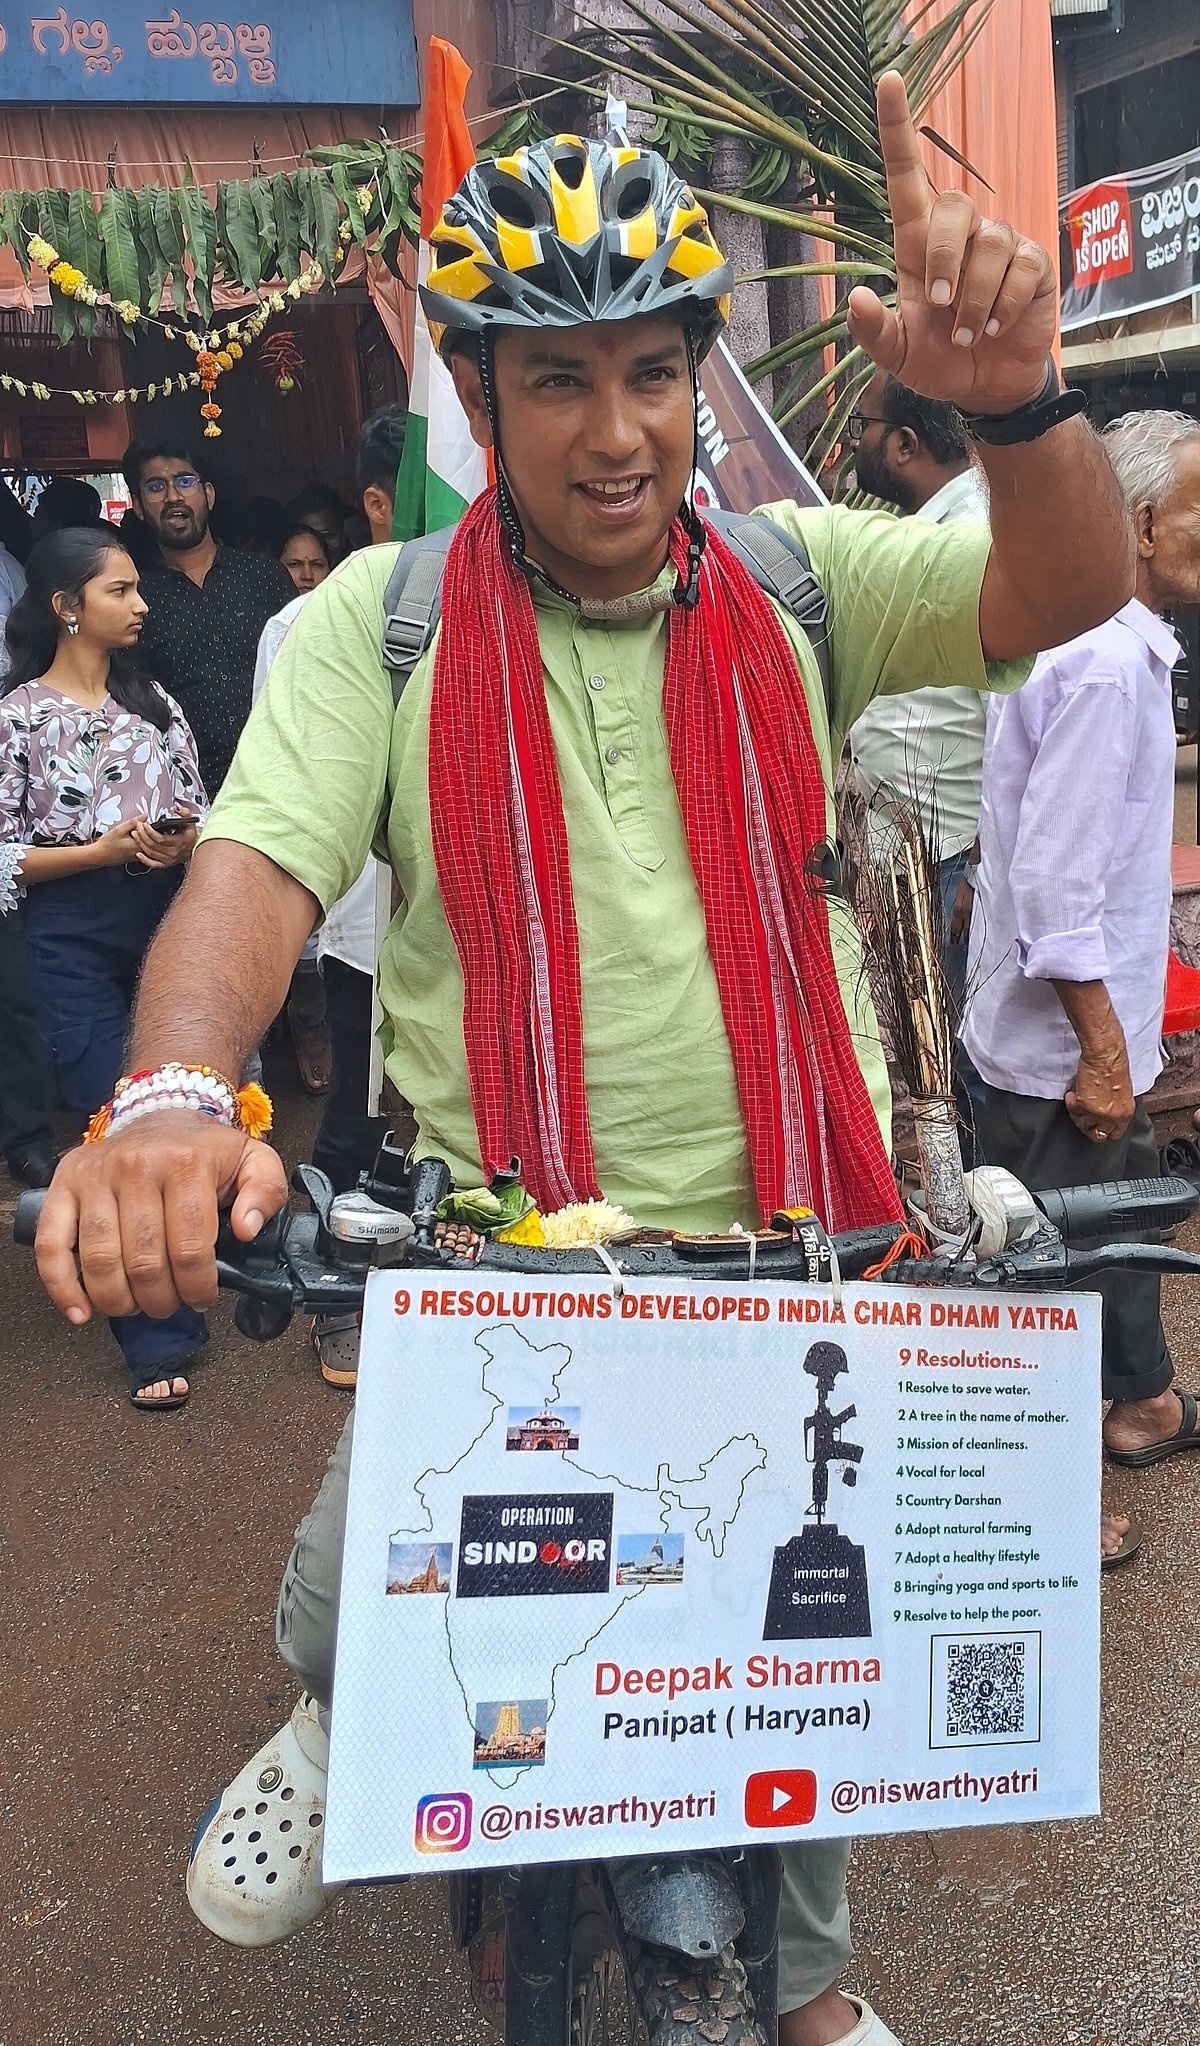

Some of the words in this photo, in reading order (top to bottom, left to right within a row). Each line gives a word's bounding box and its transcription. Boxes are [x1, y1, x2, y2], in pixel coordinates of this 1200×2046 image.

[144, 8, 277, 85] ಹುಬ್ಬಳ್ಳಿ
[1081, 200, 1120, 239] SHOP
[1075, 239, 1090, 274] IS
[1091, 226, 1130, 269] OPEN
[395, 1290, 409, 1315] 9
[421, 1291, 612, 1318] RESOLUTIONS
[621, 1293, 770, 1321] DEVELOPED
[779, 1299, 846, 1323] INDIA
[854, 1301, 921, 1325] CHAR
[931, 1304, 999, 1328] DHAM
[1007, 1306, 1078, 1330] YATRA
[900, 1348, 911, 1365] 9
[917, 1349, 1038, 1369] Resolutions...
[906, 1381, 948, 1393] Resolve
[952, 1384, 963, 1393] to
[995, 1385, 1030, 1394] water.
[898, 1409, 905, 1420] 2
[909, 1409, 917, 1420] A
[921, 1411, 943, 1421] tree
[946, 1410, 956, 1421] in
[960, 1410, 977, 1421] the
[1014, 1410, 1025, 1422] of
[1028, 1411, 1068, 1422] mother.
[897, 1437, 904, 1449] 3
[907, 1438, 949, 1449] Mission
[952, 1437, 964, 1449] of
[966, 1438, 1027, 1449] cleanliness.
[896, 1466, 904, 1477] 4
[906, 1465, 936, 1477] Vocal
[940, 1465, 956, 1477] for
[960, 1465, 984, 1477] local
[896, 1494, 902, 1506] 5
[906, 1494, 952, 1509] Country
[955, 1494, 1001, 1505] Darshan
[501, 1507, 574, 1526] OPERATION
[895, 1523, 902, 1535] 6
[906, 1523, 940, 1538] Adopt
[944, 1521, 984, 1534] natural
[988, 1521, 1031, 1536] farming
[463, 1539, 607, 1565] SINDOOR
[895, 1552, 902, 1564] 7
[905, 1551, 940, 1566] Adopt
[954, 1550, 995, 1565] healthy
[999, 1549, 1039, 1564] lifestyle
[793, 1567, 849, 1580] immortal
[894, 1581, 901, 1593] 8
[905, 1580, 952, 1595] Bringing
[956, 1583, 984, 1594] yoga
[987, 1578, 1008, 1590] and
[1012, 1579, 1045, 1592] sports
[1049, 1579, 1059, 1588] to
[1063, 1576, 1078, 1587] life
[791, 1592, 847, 1605] Sacrifice
[894, 1610, 901, 1622] 9
[905, 1608, 947, 1621] Resolve
[950, 1610, 961, 1620] to
[965, 1607, 988, 1622] help
[992, 1606, 1009, 1618] the
[1012, 1609, 1041, 1621] poor.
[596, 1658, 733, 1700] Deepak
[746, 1655, 880, 1688] Sharma
[604, 1709, 716, 1742] Panipat
[746, 1699, 870, 1735] Haryana)
[481, 1791, 715, 1840] @niswarthyatri
[832, 1768, 1037, 1813] @niswarthyatri
